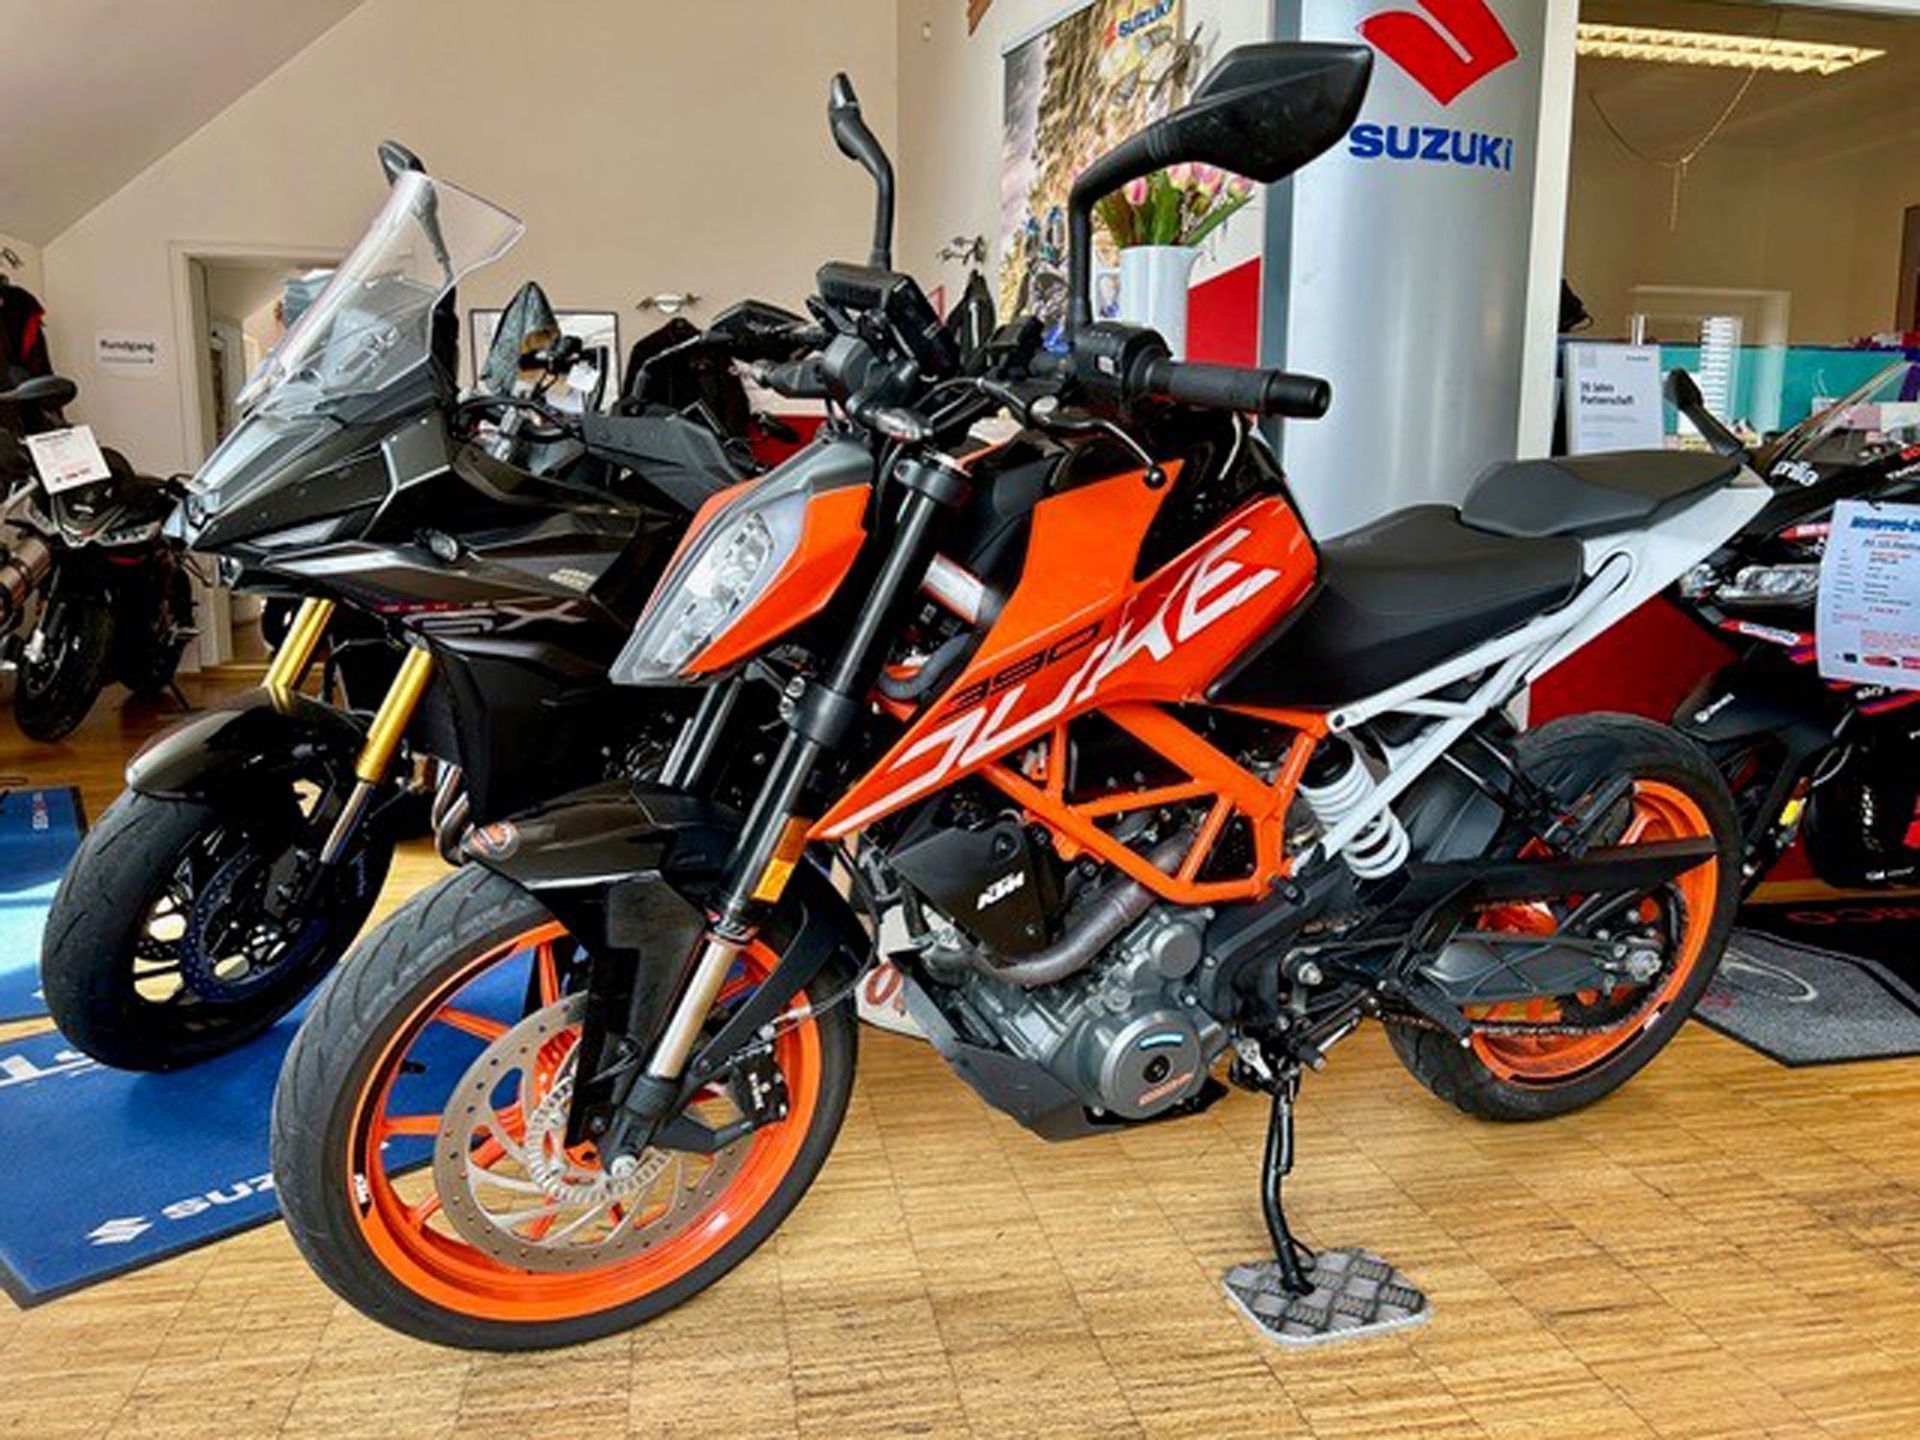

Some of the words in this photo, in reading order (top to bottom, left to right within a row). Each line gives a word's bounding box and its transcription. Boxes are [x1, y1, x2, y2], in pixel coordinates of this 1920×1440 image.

[1349, 123, 1513, 171] SUZUKI
[840, 527, 1281, 818] DUKE
[935, 621, 1103, 725] 390
[977, 871, 1025, 910] KTM
[161, 1172, 278, 1220] SUZ
